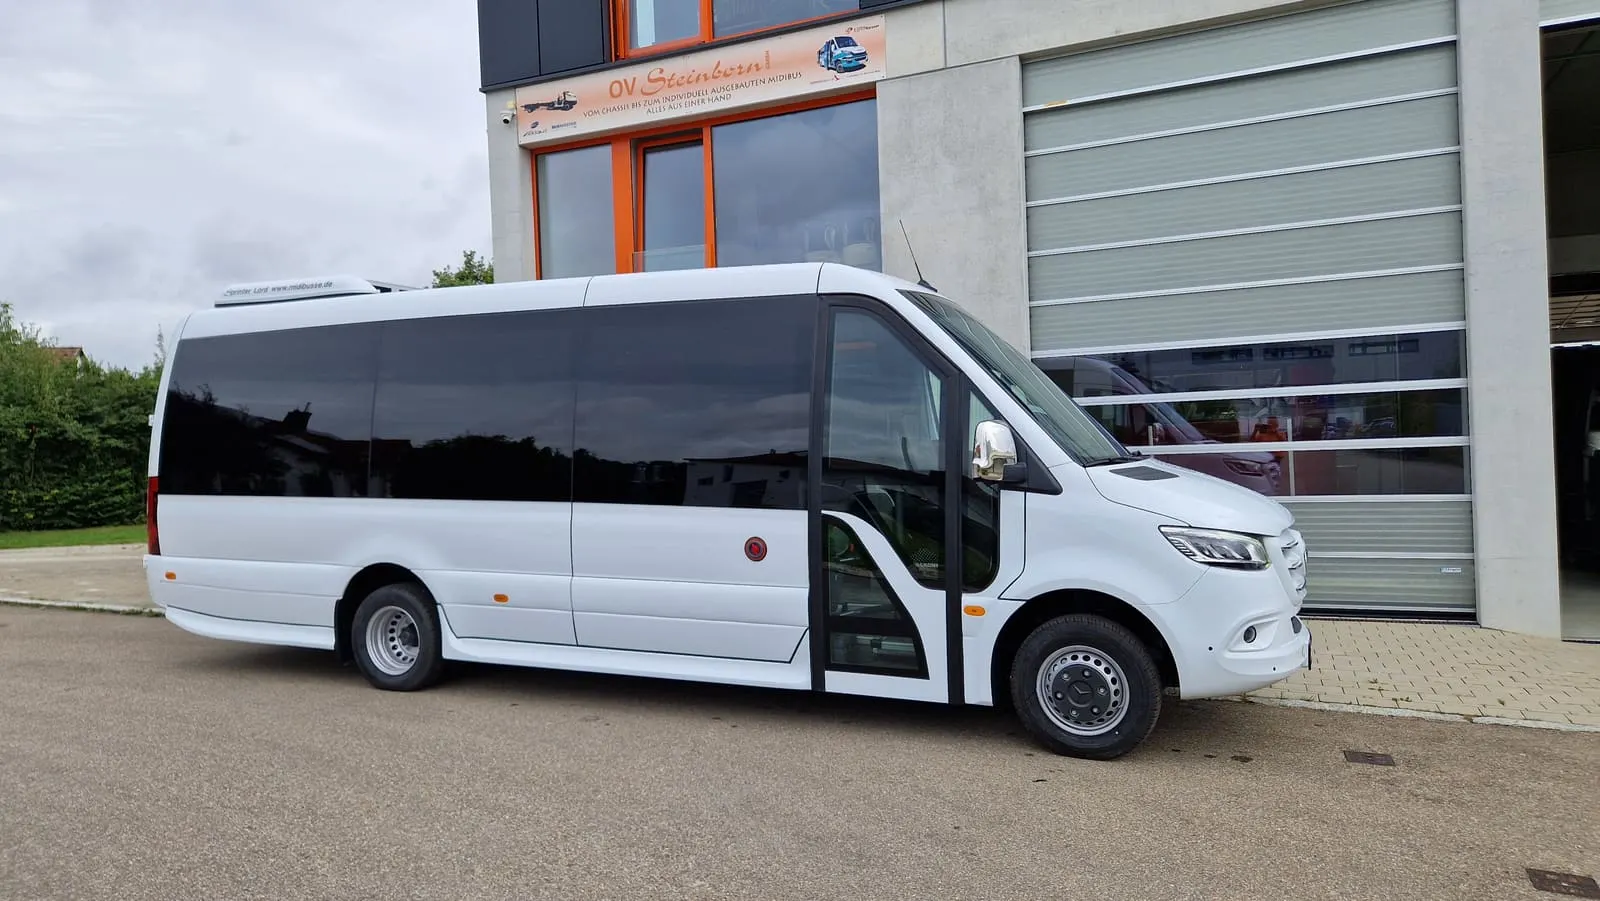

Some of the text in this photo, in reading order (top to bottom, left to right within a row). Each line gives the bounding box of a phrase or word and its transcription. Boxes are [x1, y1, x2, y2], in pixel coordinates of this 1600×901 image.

[583, 109, 600, 118] VOM
[632, 101, 641, 109] BIS
[643, 98, 659, 106] ZUM
[662, 89, 708, 103] INDIVIDUELL
[710, 78, 766, 94] AUSGEBAUTEN
[767, 71, 802, 84] MIDIBUS
[609, 60, 762, 98] OV Steinborn
[646, 93, 731, 115] ALLES AUS EINER HAND
